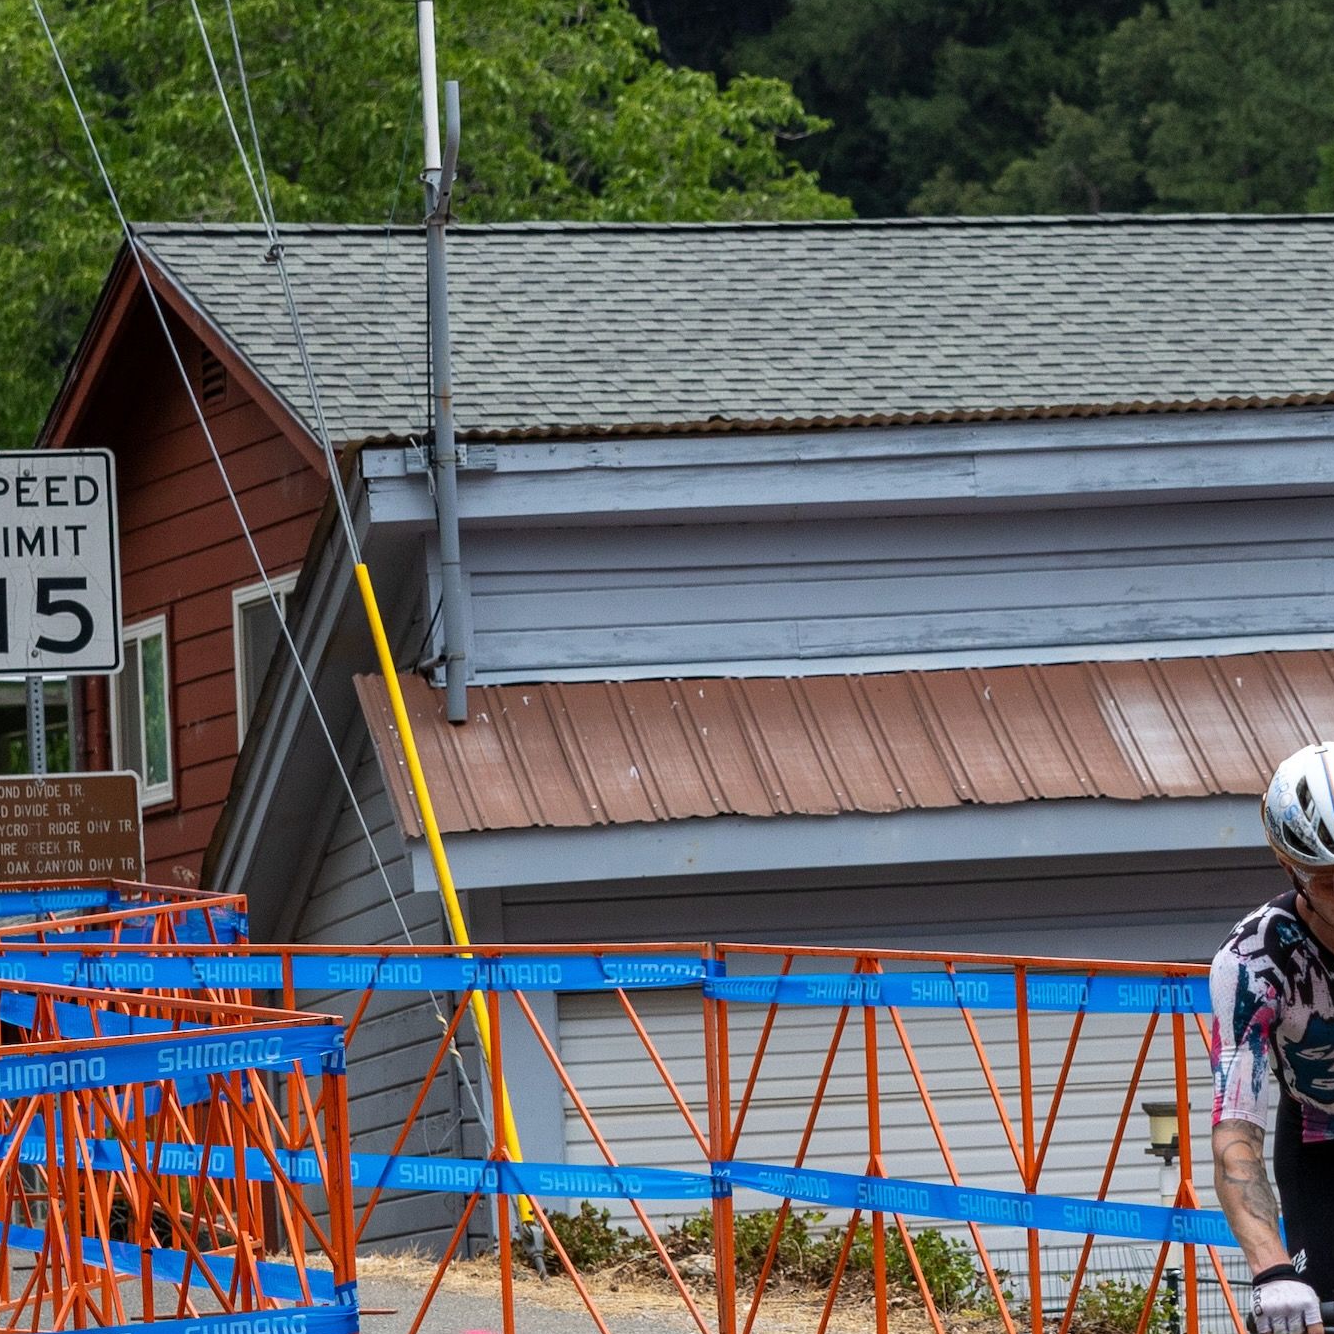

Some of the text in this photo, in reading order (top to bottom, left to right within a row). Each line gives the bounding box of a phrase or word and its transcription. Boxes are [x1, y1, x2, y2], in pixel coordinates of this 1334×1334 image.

[26, 784, 61, 799] DIVIDE
[14, 803, 49, 818] DIVIDE
[49, 821, 80, 834] RIDGE
[87, 819, 110, 834] OHV
[7, 861, 30, 874] OAK
[37, 859, 83, 873] CANYON
[90, 858, 113, 872] OHV
[62, 963, 154, 983] SHIMANO
[328, 963, 422, 984] SHIMANO
[462, 963, 562, 985] SHIMANO
[807, 981, 880, 1000] SHIMANO
[911, 980, 989, 1003] SHIMANO
[1118, 984, 1194, 1008] SHIMANO
[158, 1036, 283, 1074] SHIMANO
[262, 1158, 359, 1181] SHIMO
[400, 1163, 499, 1188] SHIMANO
[539, 1171, 642, 1194] SHIMANO
[758, 1171, 830, 1199] SHIMANO
[857, 1182, 929, 1211] SHIMANO
[957, 1194, 1033, 1223] SHIMANO
[1063, 1205, 1142, 1234] SHIMANO
[1172, 1215, 1232, 1241] SHIMA
